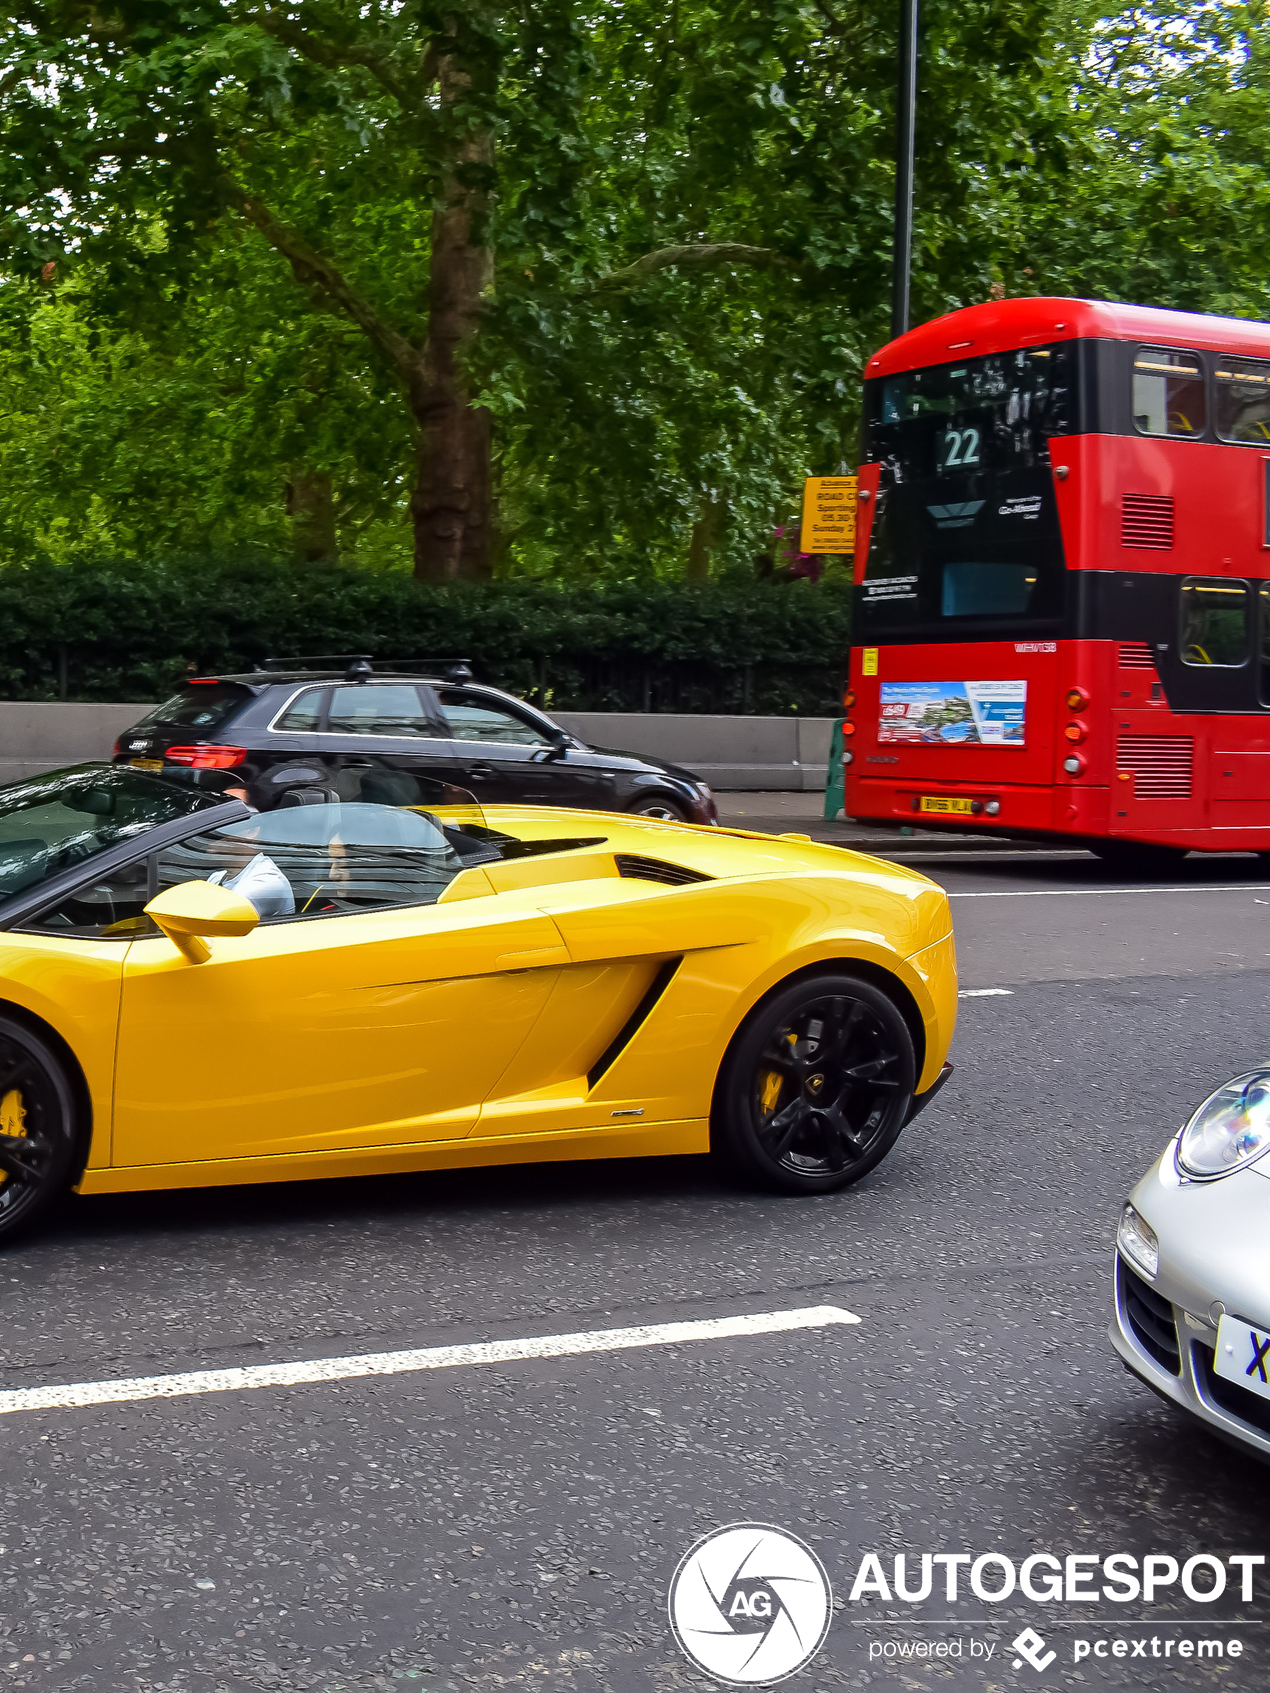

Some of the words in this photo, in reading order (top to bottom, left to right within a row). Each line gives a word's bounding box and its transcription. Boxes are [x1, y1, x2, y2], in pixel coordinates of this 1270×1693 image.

[944, 428, 980, 466] 22
[816, 492, 845, 501] ROAD
[811, 524, 845, 533] Sunday
